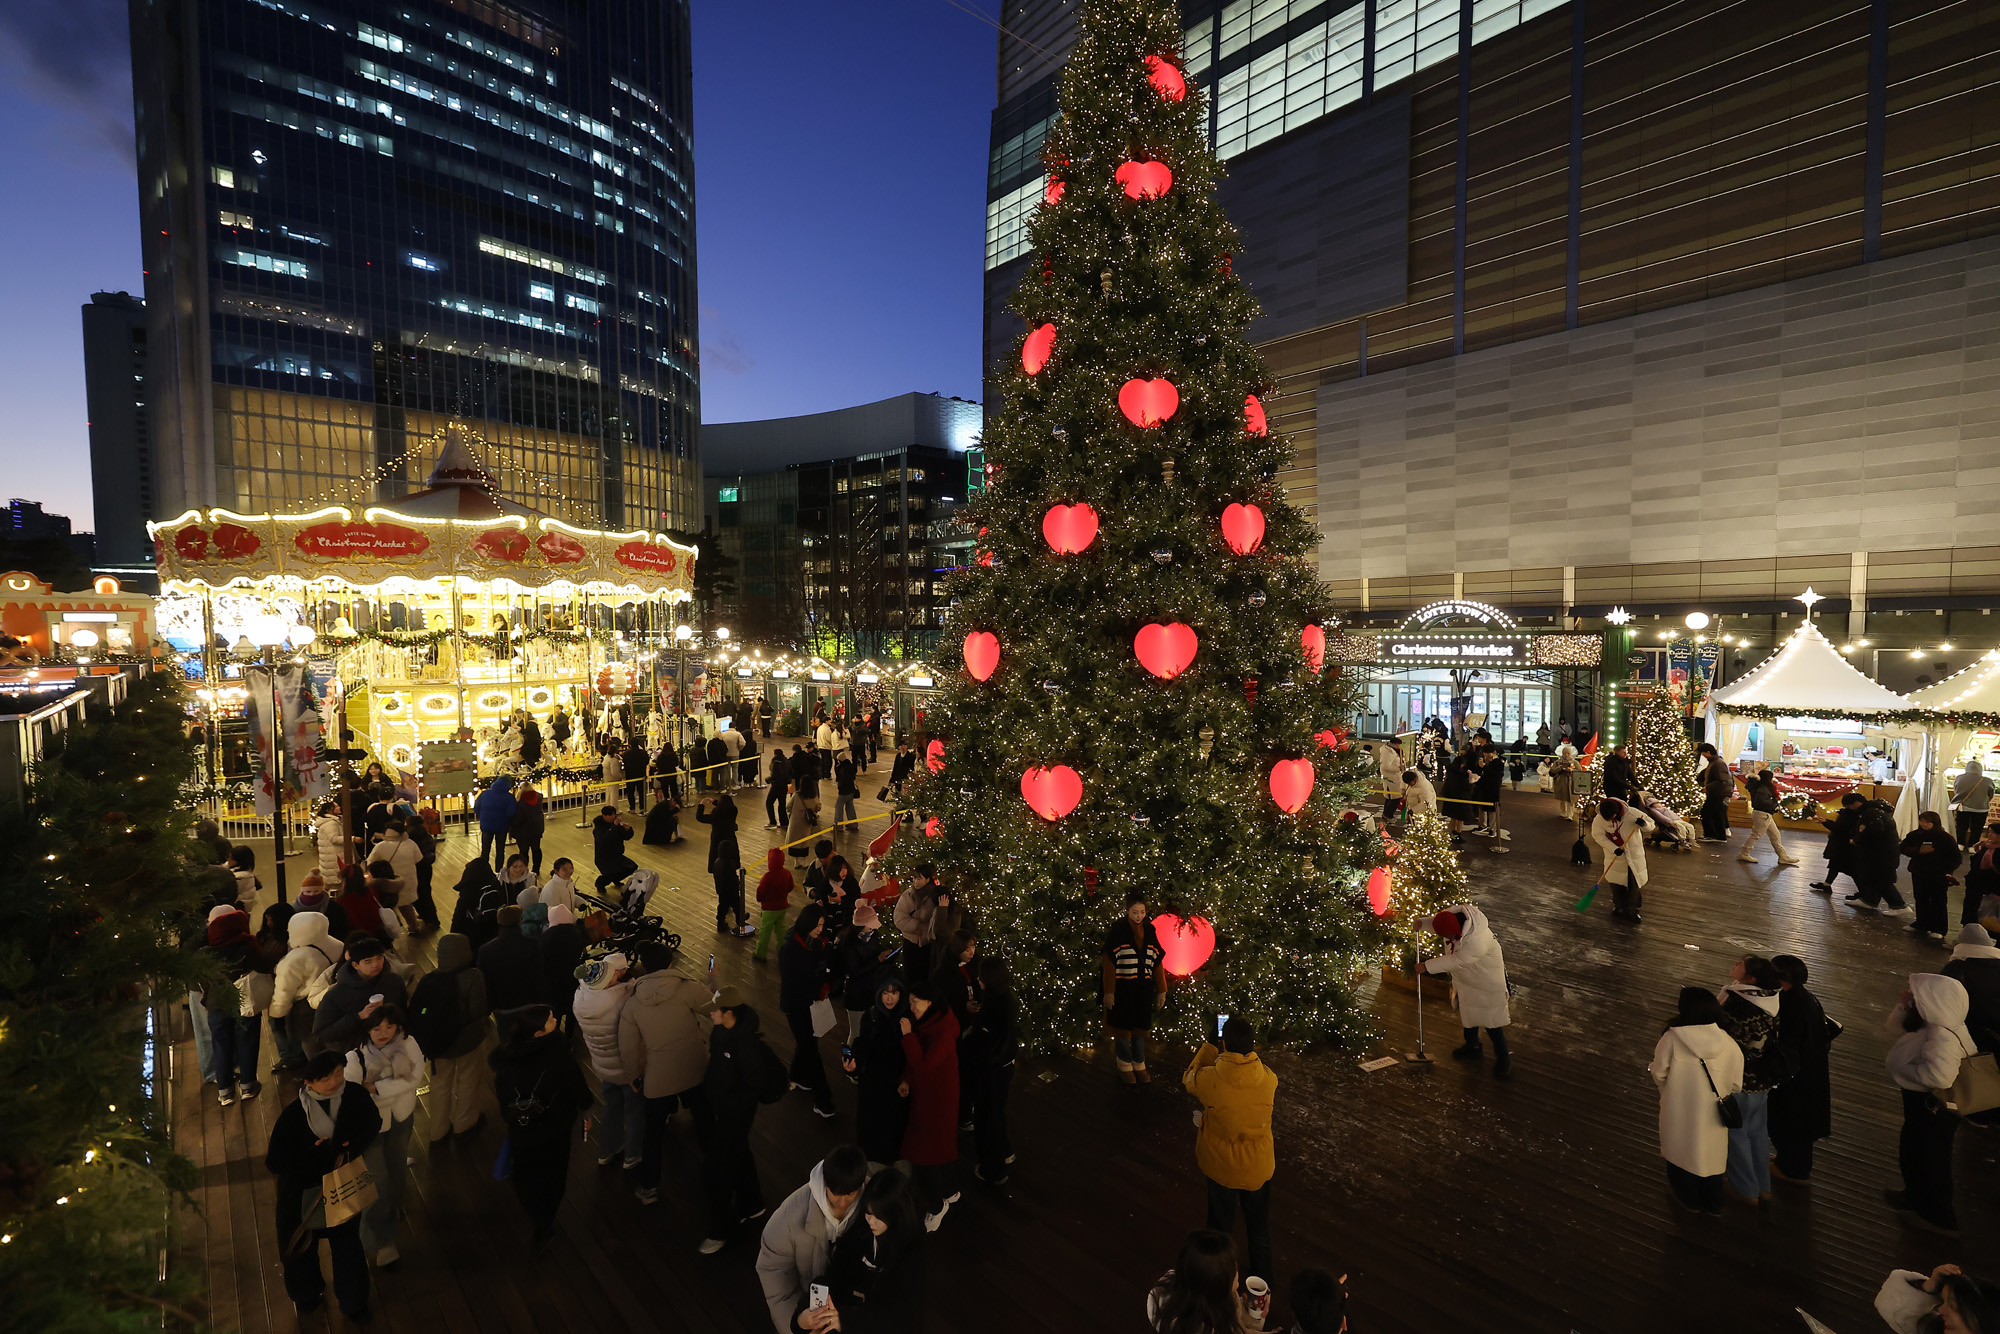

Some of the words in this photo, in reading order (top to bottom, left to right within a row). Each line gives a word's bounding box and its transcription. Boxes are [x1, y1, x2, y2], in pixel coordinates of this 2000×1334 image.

[317, 536, 371, 548] Christmas
[372, 540, 406, 548] Market
[628, 551, 656, 563] Christmas
[1416, 605, 1454, 624] LOTTE
[1454, 605, 1492, 624] TOWN
[1391, 643, 1459, 656] Christmas
[1461, 644, 1514, 657] Market
